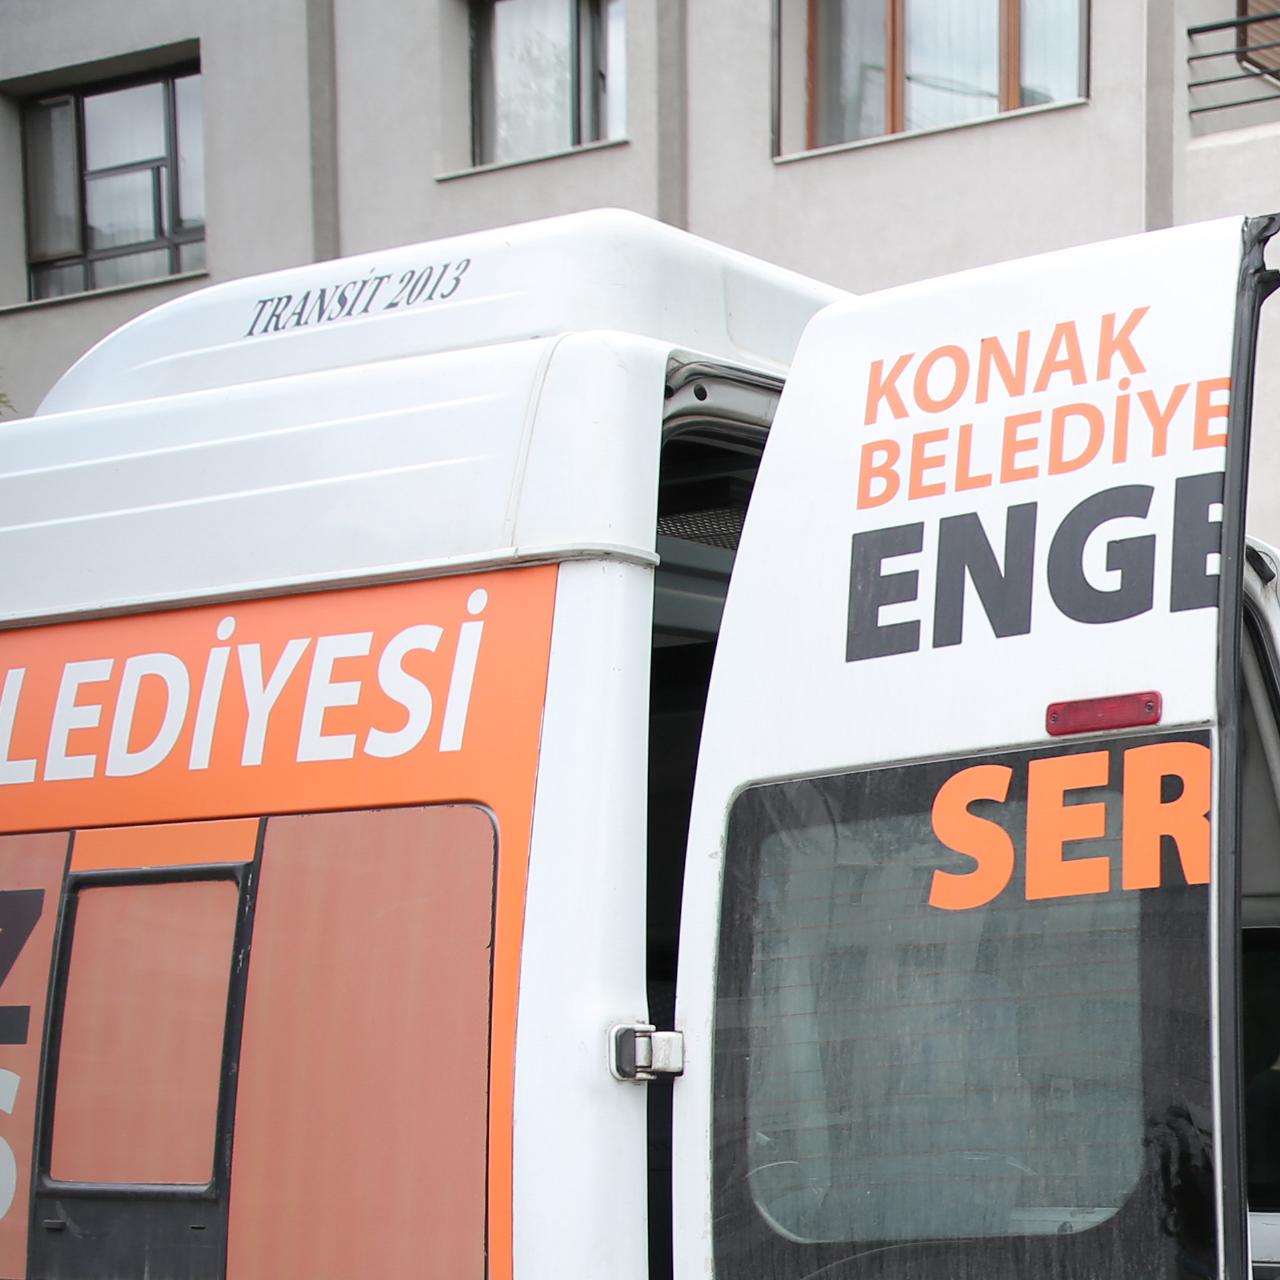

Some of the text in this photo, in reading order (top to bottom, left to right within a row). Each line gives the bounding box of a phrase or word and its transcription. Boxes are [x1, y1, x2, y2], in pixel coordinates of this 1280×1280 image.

[383, 258, 471, 310] 2013
[863, 305, 1152, 426] KONAK
[856, 377, 1232, 511] BELEDİYE
[928, 741, 1211, 911] SER
